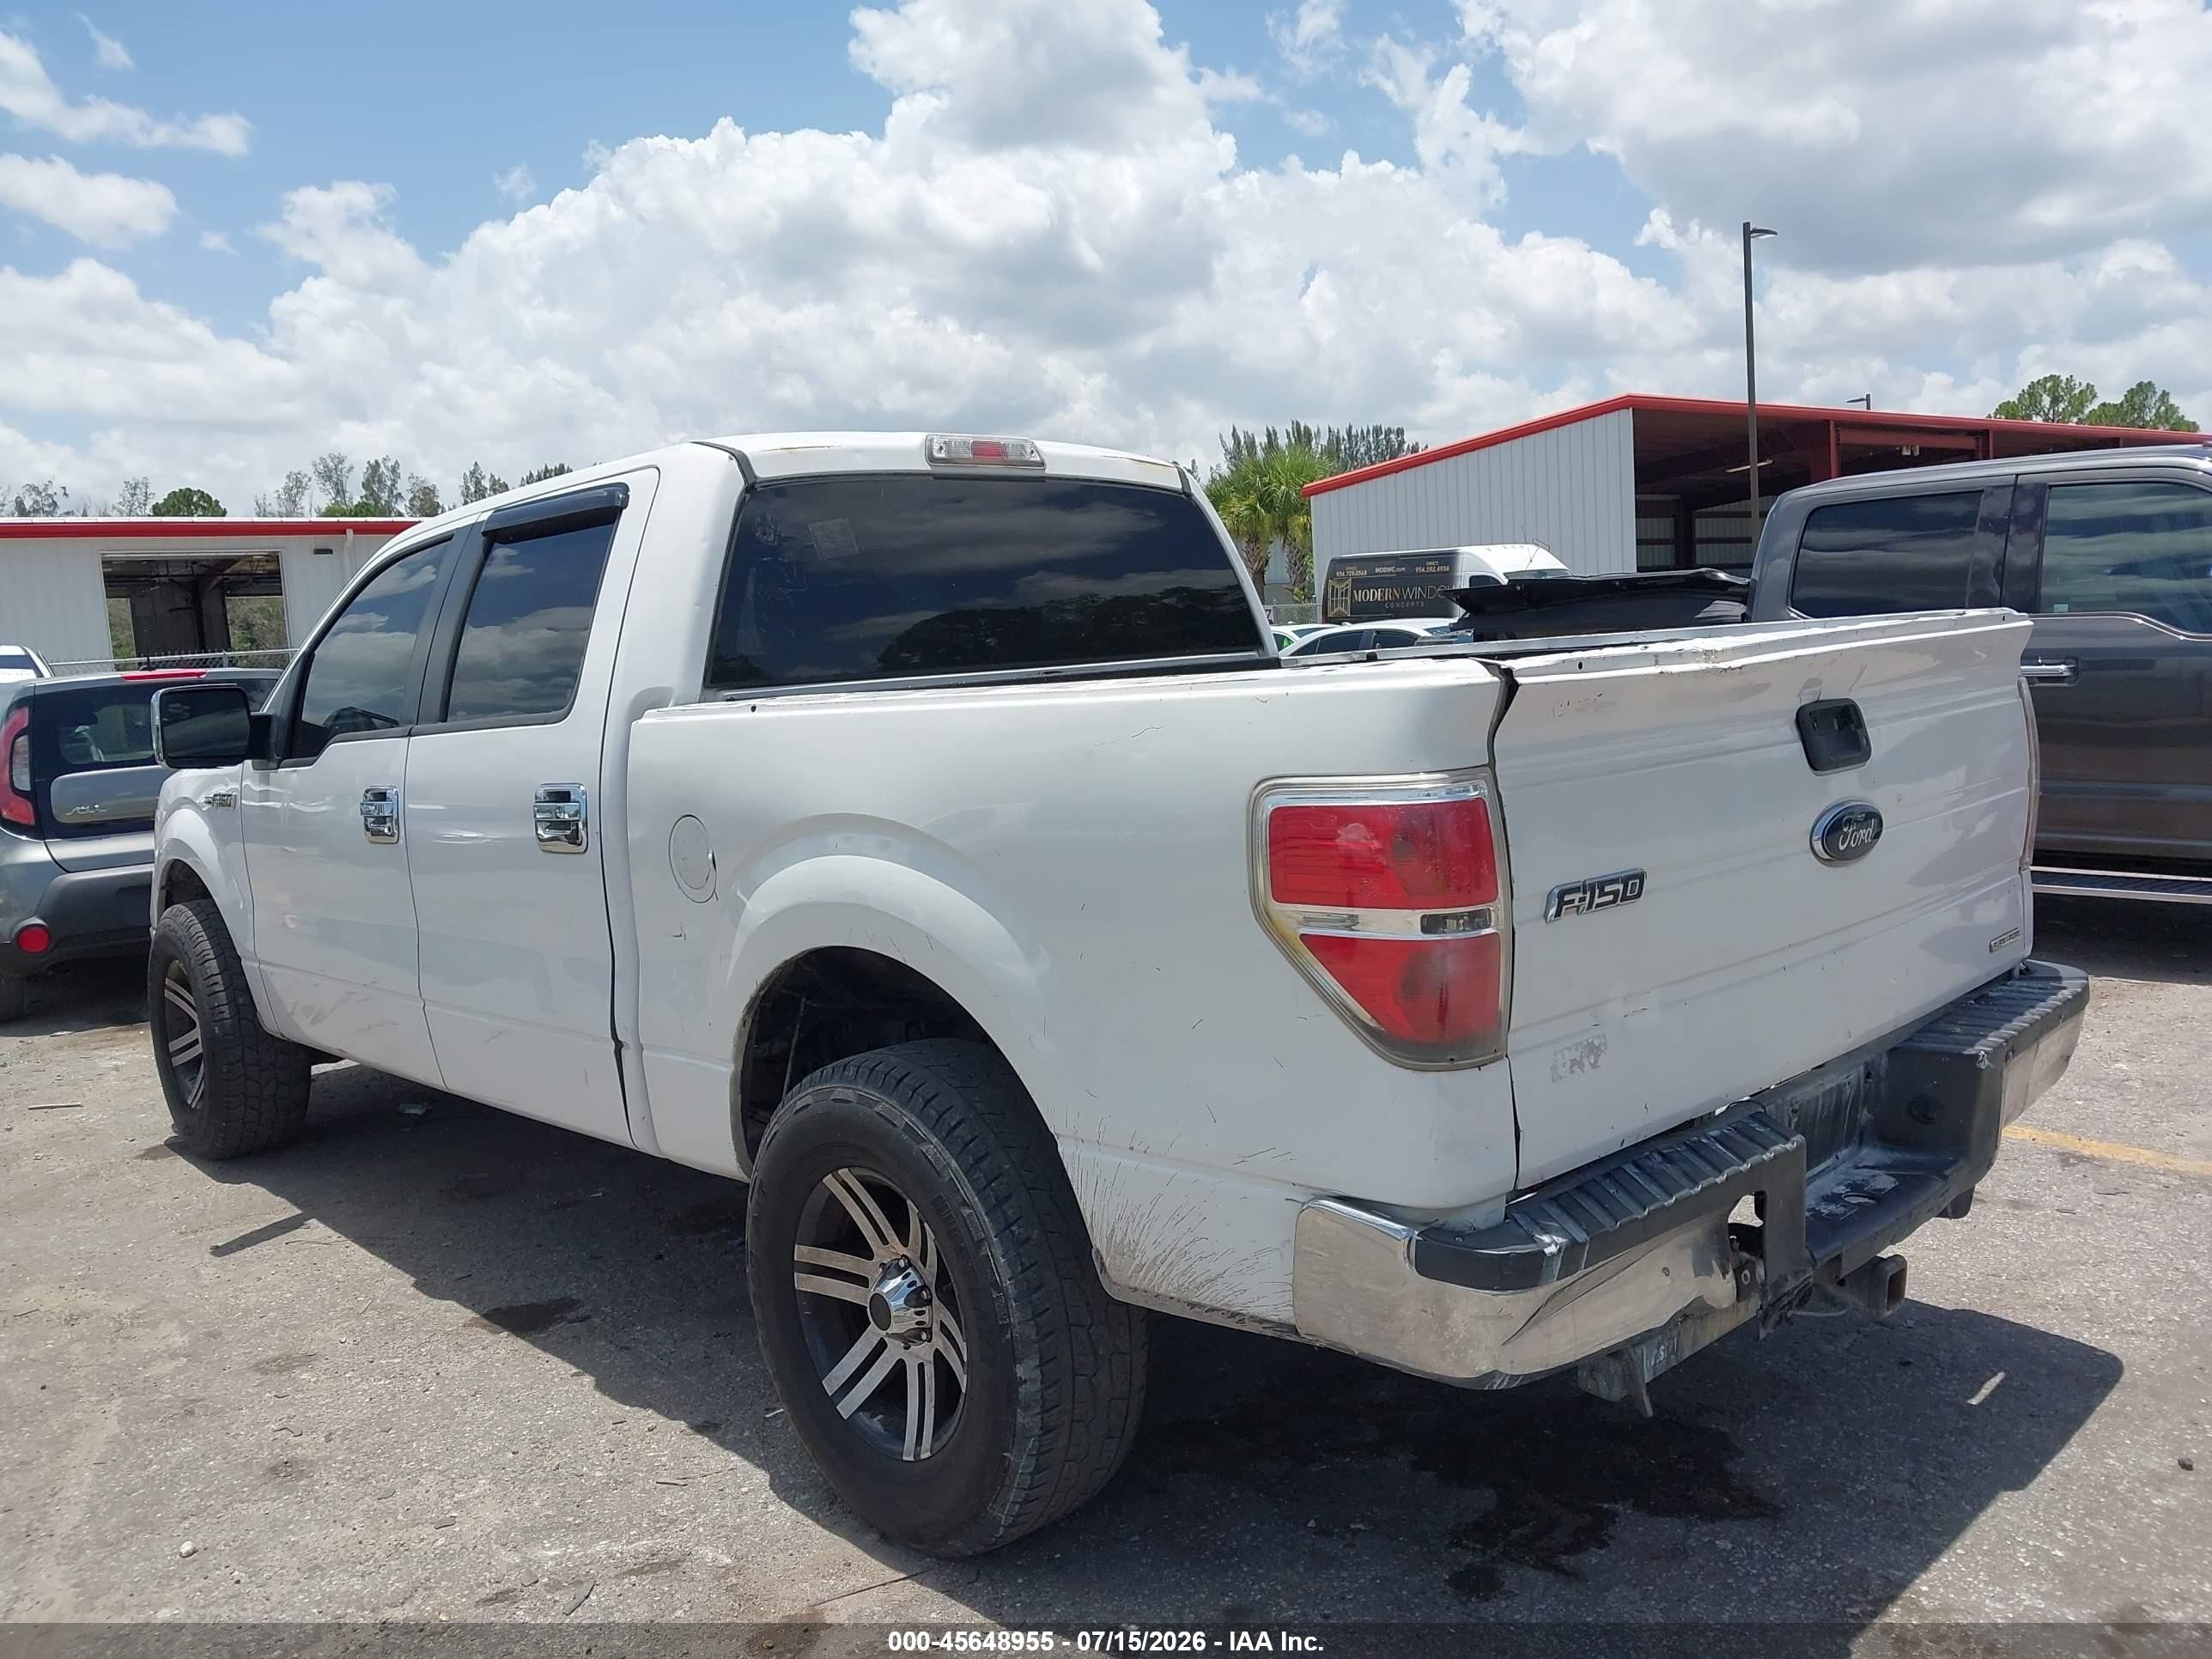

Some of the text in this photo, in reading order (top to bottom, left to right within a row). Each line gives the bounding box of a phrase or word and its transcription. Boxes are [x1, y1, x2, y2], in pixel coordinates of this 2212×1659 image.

[1353, 585, 1458, 603] MODERN WINDO
[1384, 600, 1425, 609] CONCEPTS
[1838, 812, 1875, 851] Ford
[1545, 867, 1647, 923] F-150
